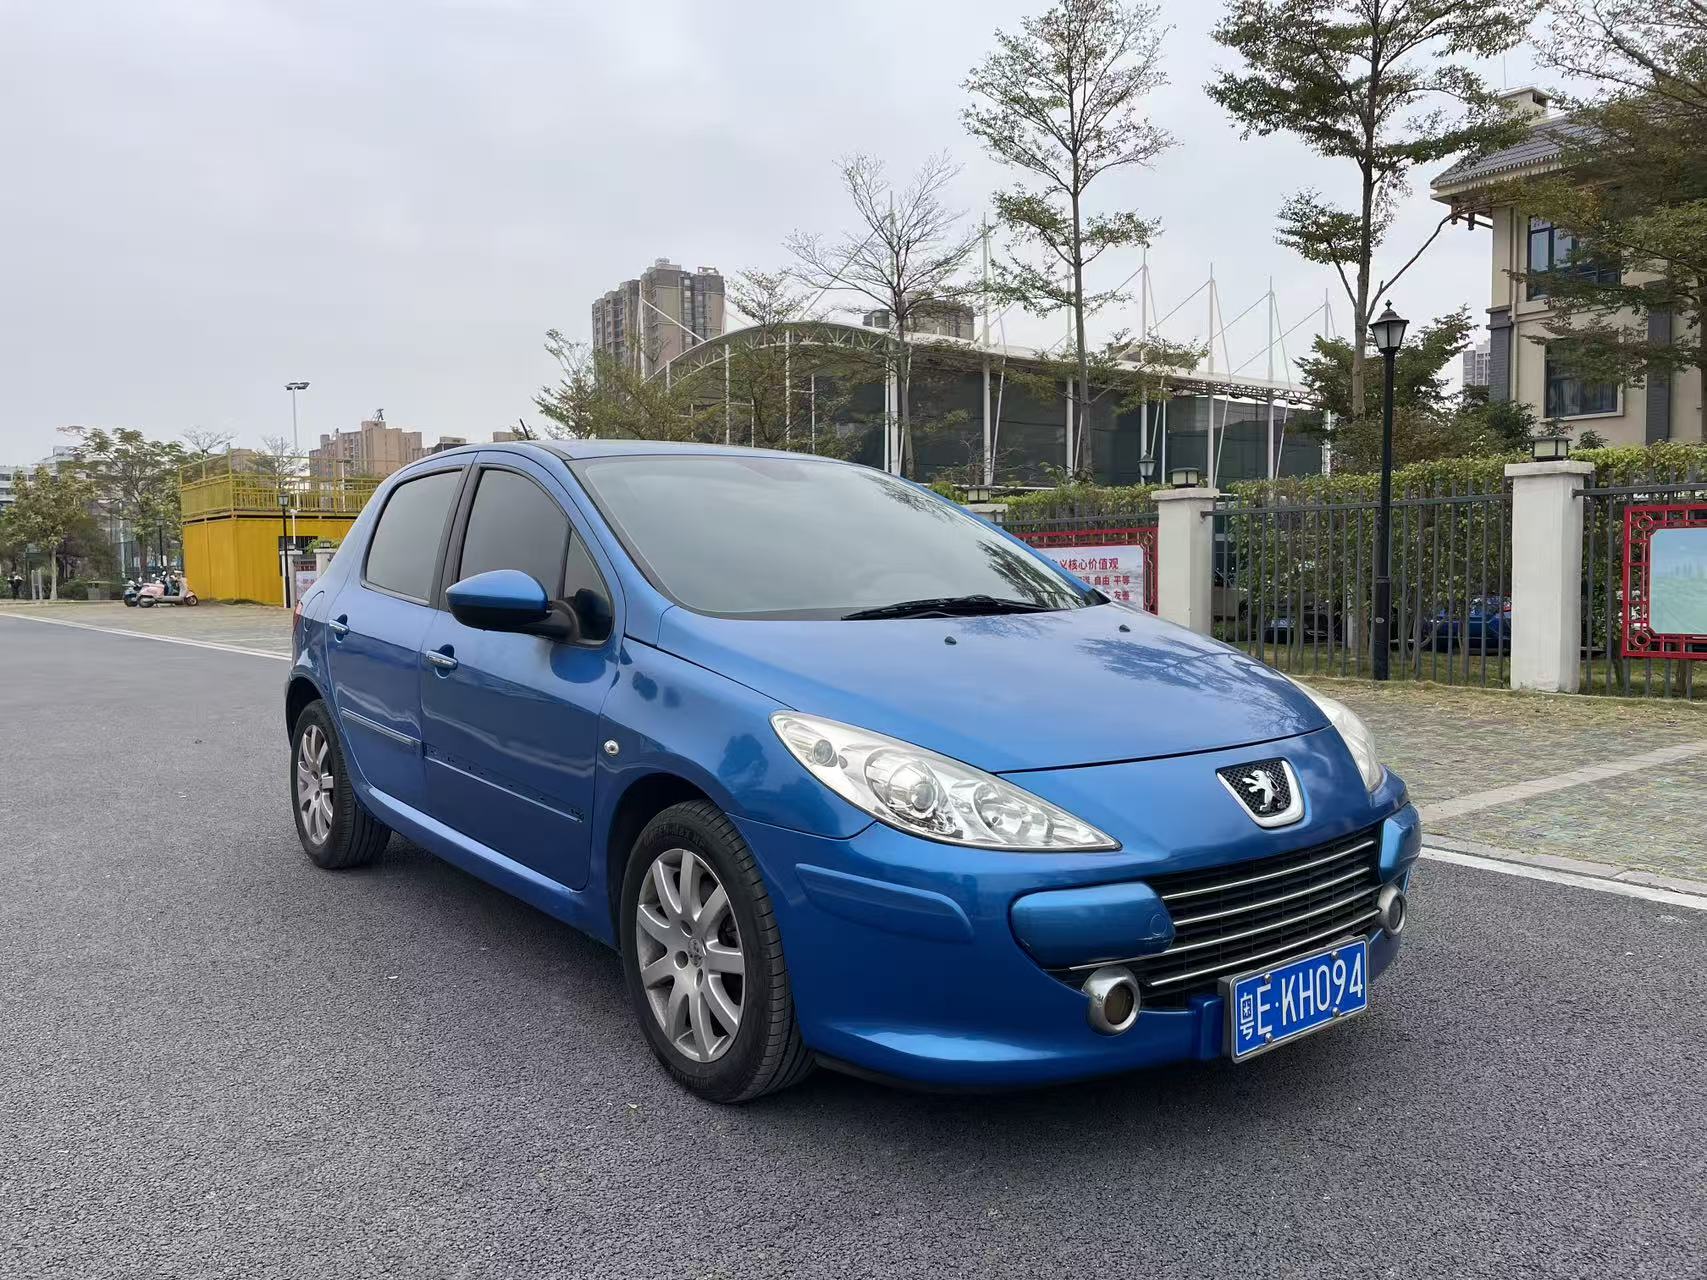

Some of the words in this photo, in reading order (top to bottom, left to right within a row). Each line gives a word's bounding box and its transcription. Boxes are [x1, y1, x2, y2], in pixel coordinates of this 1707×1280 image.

[1052, 558, 1119, 571] 义核心价值观
[1094, 575, 1110, 585] 自由
